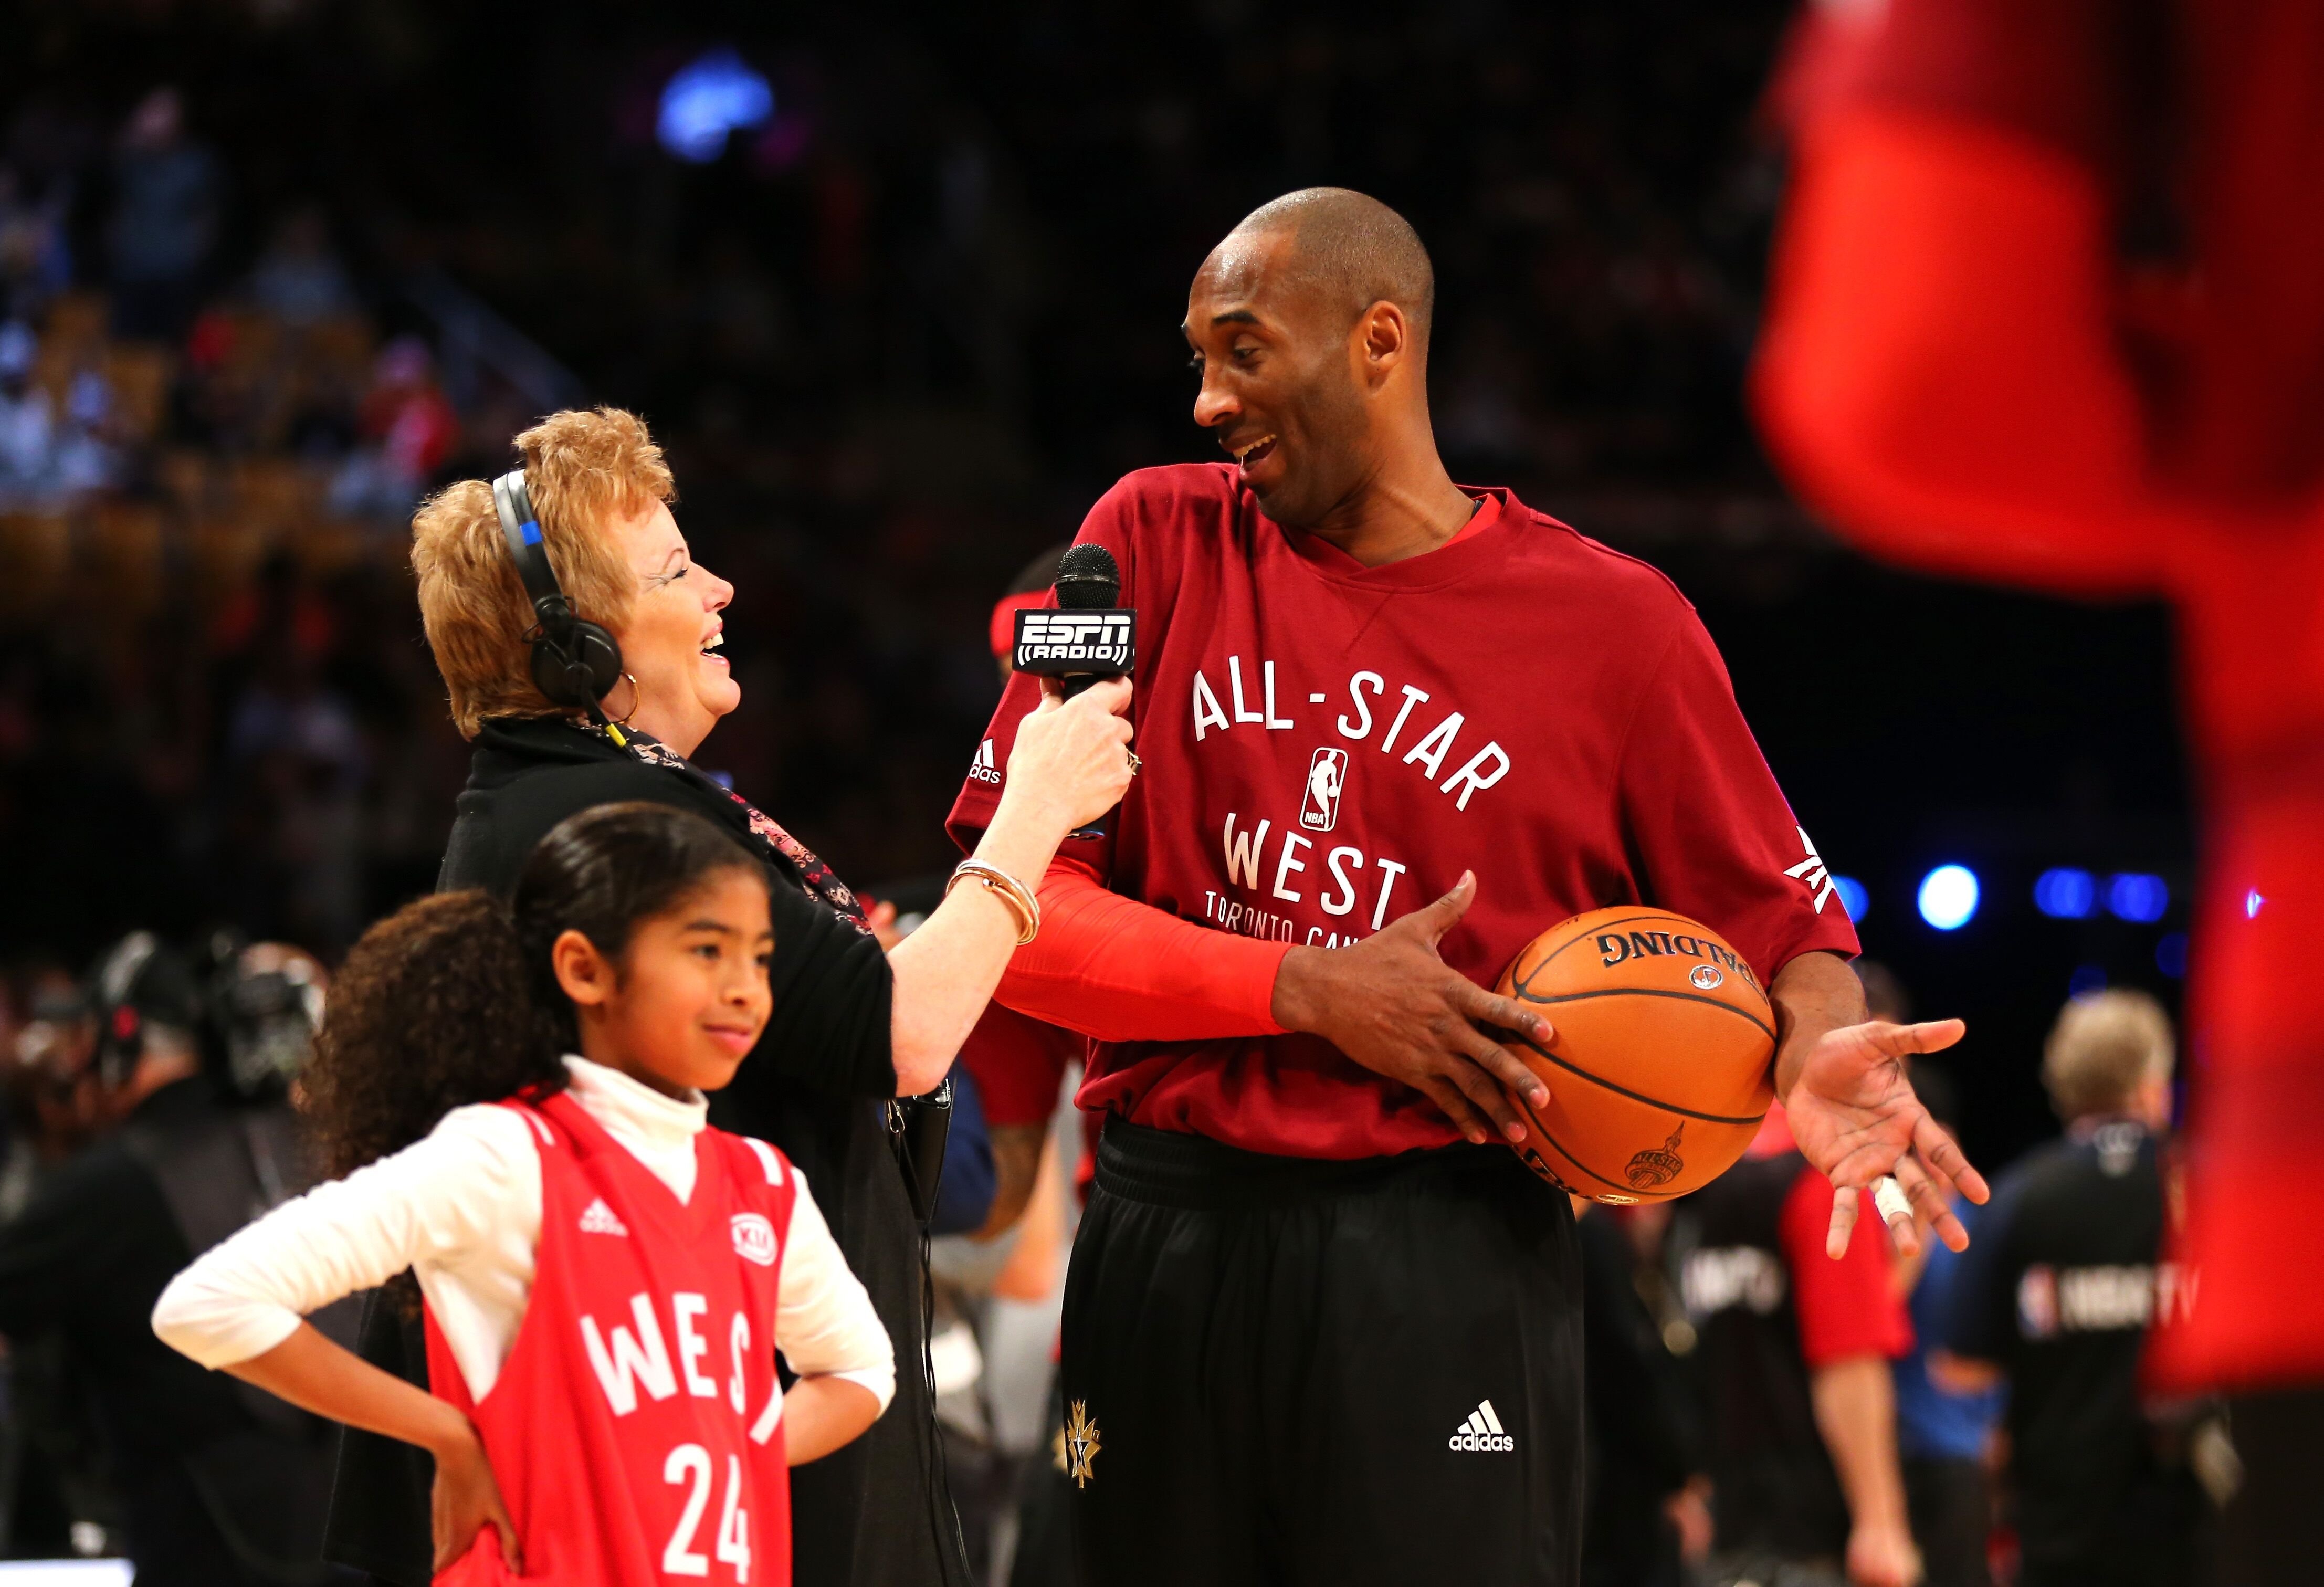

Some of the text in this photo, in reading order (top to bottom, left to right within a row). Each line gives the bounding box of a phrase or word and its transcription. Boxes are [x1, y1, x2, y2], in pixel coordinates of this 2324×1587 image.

[1021, 615, 1131, 644] ESPN
[1032, 645, 1112, 659] RADIO
[1193, 655, 1510, 812] ALL-STAR
[1305, 812, 1324, 825] NBA
[1223, 812, 1406, 930] WEST
[1205, 890, 1294, 944] TORONTO
[1448, 1432, 1514, 1452] adidas
[663, 1443, 750, 1585] 24
